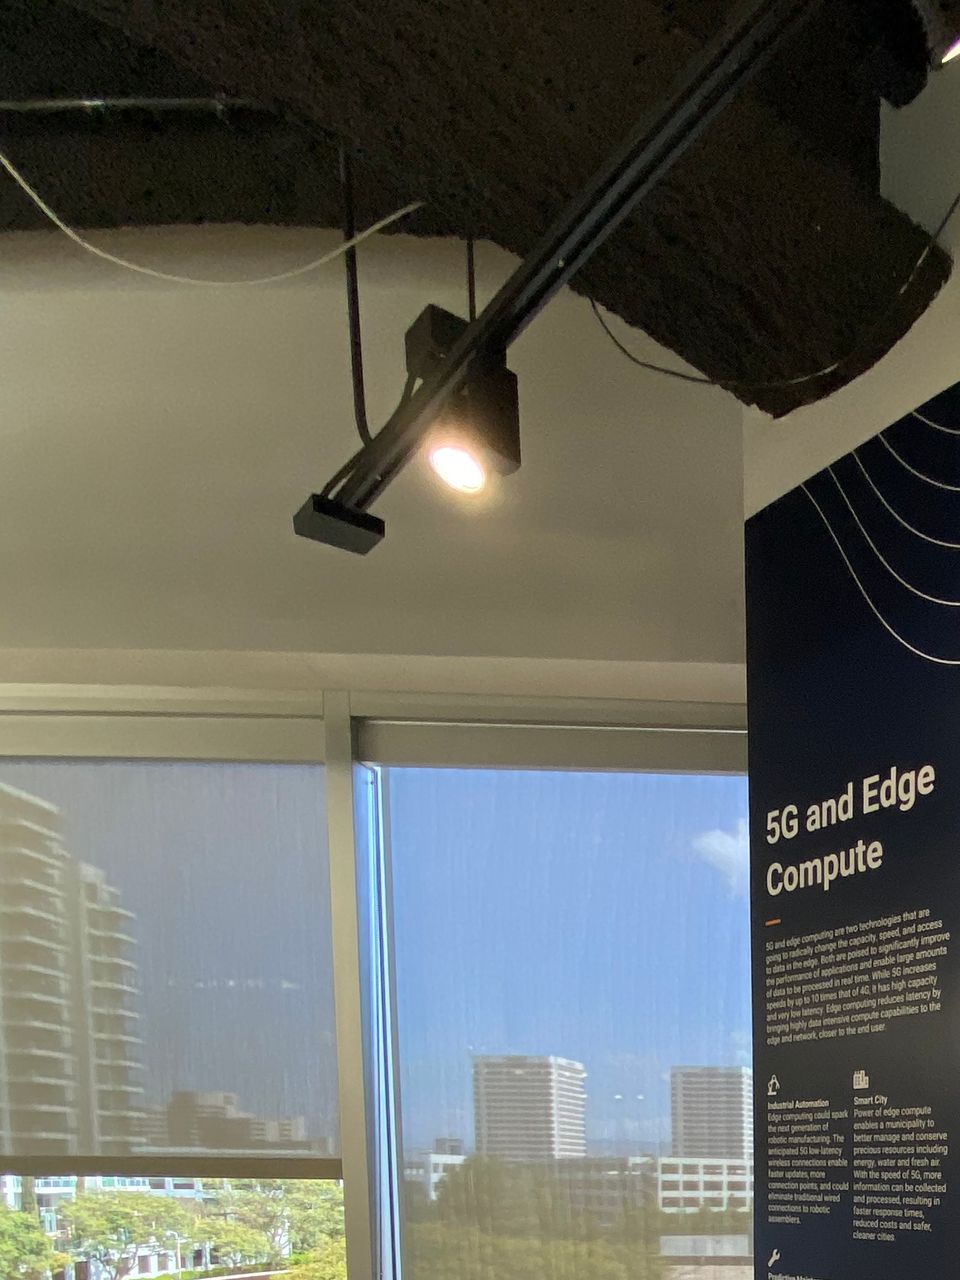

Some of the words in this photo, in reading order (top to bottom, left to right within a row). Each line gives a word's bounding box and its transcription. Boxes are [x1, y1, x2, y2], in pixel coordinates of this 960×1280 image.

[766, 804, 799, 844] 5G
[806, 782, 854, 832] and
[862, 765, 936, 812] Edge
[766, 840, 883, 896] Compute
[766, 940, 773, 950] 5G
[775, 938, 785, 948] and
[786, 936, 800, 946] edge
[801, 929, 833, 942] computing
[834, 927, 844, 935] are
[845, 924, 858, 933] two
[859, 915, 901, 930] technologies
[902, 910, 916, 921] that
[918, 909, 930, 918] are
[766, 952, 781, 964] going
[814, 941, 837, 952] change
[838, 938, 848, 947] the
[902, 923, 916, 935] and
[917, 920, 942, 932] access
[773, 963, 785, 972] data
[821, 952, 835, 963] Both
[836, 952, 846, 960] are
[847, 946, 869, 961] poised
[870, 946, 877, 954] to
[878, 937, 919, 954] significantly
[920, 932, 950, 946] improve
[813, 968, 820, 977] of
[860, 958, 872, 969] and
[873, 955, 896, 966] enable
[897, 952, 914, 963] large
[915, 946, 947, 959] amounts
[802, 978, 833, 993] processed
[834, 978, 840, 986] in
[841, 974, 853, 985] real
[871, 969, 890, 980] While
[891, 966, 901, 976] 5G
[903, 962, 936, 975] increases
[767, 998, 786, 1010] speeds
[787, 997, 794, 1007] by
[811, 992, 820, 1002] 10
[820, 992, 837, 1001] times
[838, 988, 850, 998] that
[852, 986, 858, 996] of
[878, 982, 890, 992] has
[891, 979, 906, 991] high
[908, 975, 937, 988] capacity
[767, 1011, 777, 1020] and
[826, 1003, 841, 1013] Edge
[842, 998, 876, 1010] computing
[878, 994, 904, 1005] reduces
[905, 990, 931, 1001] latency
[932, 987, 942, 999] by
[851, 1010, 879, 1022] compute
[880, 1005, 919, 1019] capabilities
[920, 1004, 928, 1012] to
[929, 1001, 940, 1011] the
[819, 1029, 837, 1038] closer
[838, 1028, 845, 1036] to
[846, 1026, 856, 1035] the
[857, 1023, 870, 1033] end
[854, 1096, 872, 1105] Smart
[874, 1095, 888, 1106] City
[854, 1108, 874, 1117] Power
[875, 1107, 882, 1116] of
[883, 1107, 900, 1118] edge
[901, 1106, 932, 1117] compute
[854, 1120, 878, 1129] enables
[886, 1118, 926, 1130] municipality
[927, 1119, 934, 1127] to
[854, 1132, 872, 1141] better
[874, 1133, 900, 1143] manage
[901, 1131, 914, 1140] and
[916, 1132, 948, 1140] conserve
[854, 1145, 880, 1156] precious
[916, 1143, 948, 1155] including
[878, 1157, 896, 1165] water
[897, 1157, 910, 1165] and
[911, 1156, 929, 1166] fresh
[853, 1169, 868, 1178] With
[869, 1169, 880, 1178] the
[881, 1169, 900, 1180] speed
[902, 1169, 910, 1178] of
[853, 1181, 890, 1190] information
[905, 1182, 914, 1191] be
[915, 1182, 946, 1191] collected
[853, 1193, 866, 1202] and
[903, 1195, 932, 1207] resulting
[934, 1196, 940, 1204] in
[853, 1205, 872, 1215] faster
[873, 1208, 904, 1218] response
[853, 1218, 878, 1227] reduced
[880, 1220, 898, 1228] costs
[899, 1220, 912, 1229] and
[853, 1230, 876, 1240] cleaner
